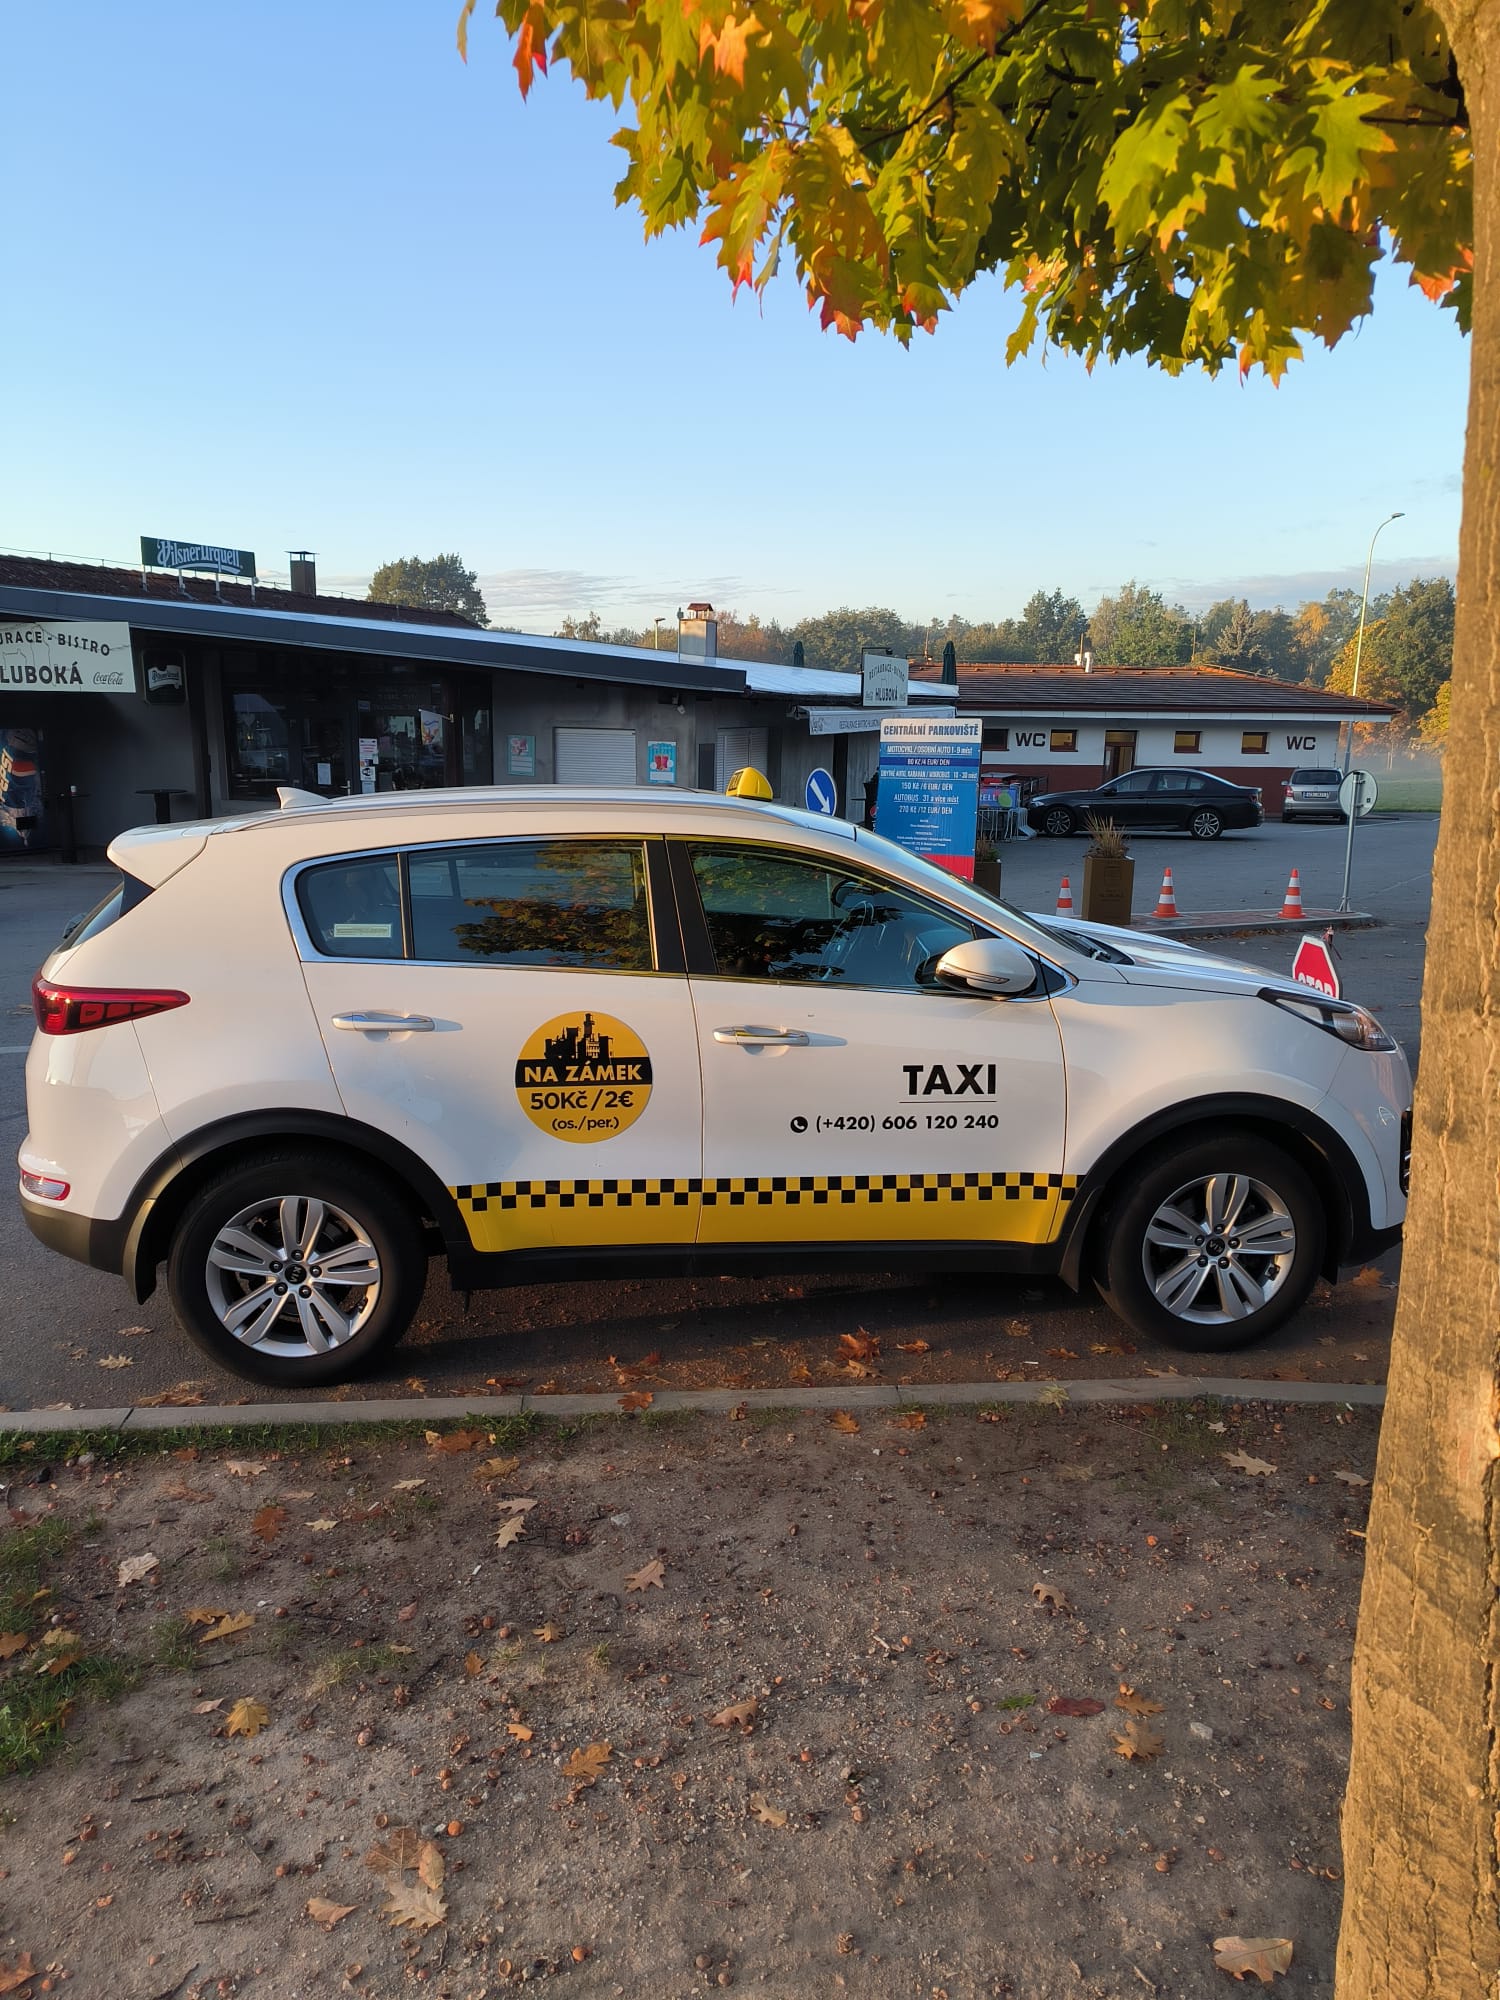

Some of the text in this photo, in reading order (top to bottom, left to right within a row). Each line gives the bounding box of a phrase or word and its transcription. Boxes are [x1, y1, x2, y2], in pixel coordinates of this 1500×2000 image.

[157, 539, 240, 573] Pilsner Urquell
[58, 633, 110, 656] BISTRO
[0, 661, 83, 685] LUBOKÁ
[884, 723, 926, 736] CENTRÁLNÍ
[928, 723, 979, 736] PARKOVIŠTĚ
[1015, 733, 1046, 747] WC
[1287, 735, 1316, 750] WC
[937, 746, 951, 754] AUTO
[894, 793, 919, 801] AUTOBUS
[941, 806, 953, 814] DEN
[524, 1060, 643, 1083] NA ZÁMEK
[902, 1064, 997, 1095] TAXI
[551, 1116, 620, 1131] (os./per.)
[816, 1114, 999, 1133] (+420) 606 120 240
